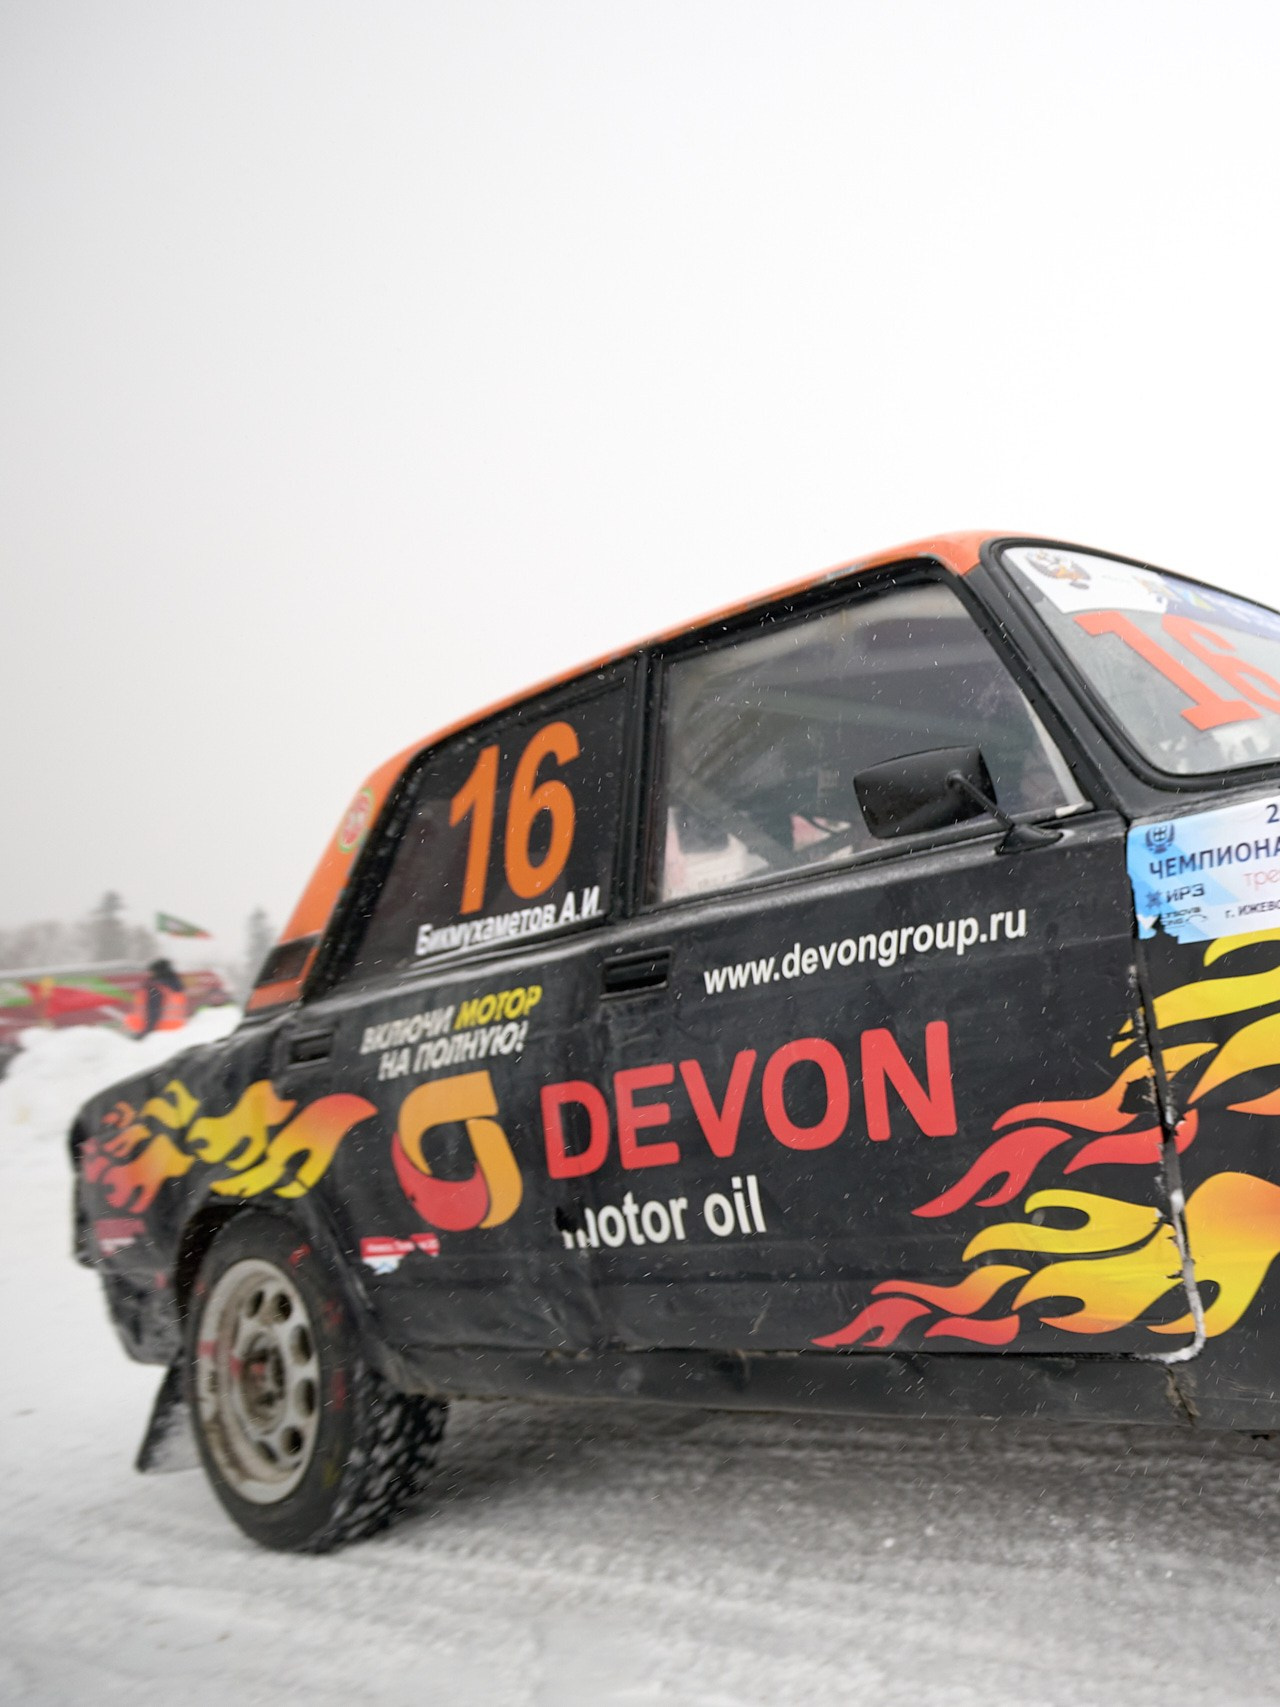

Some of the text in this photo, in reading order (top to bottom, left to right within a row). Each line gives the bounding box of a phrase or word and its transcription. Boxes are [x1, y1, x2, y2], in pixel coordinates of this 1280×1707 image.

[449, 721, 580, 915] 16
[1265, 803, 1280, 824] 2
[1166, 882, 1206, 903] ИРЗ
[703, 909, 1027, 995] www.devongroup.ru
[360, 984, 543, 1055] ВКЛЮЧИ МОТОР
[378, 1019, 530, 1081] НА ПОЛНУЮ!
[540, 1020, 958, 1180] DEVON
[703, 1174, 767, 1237] oil
